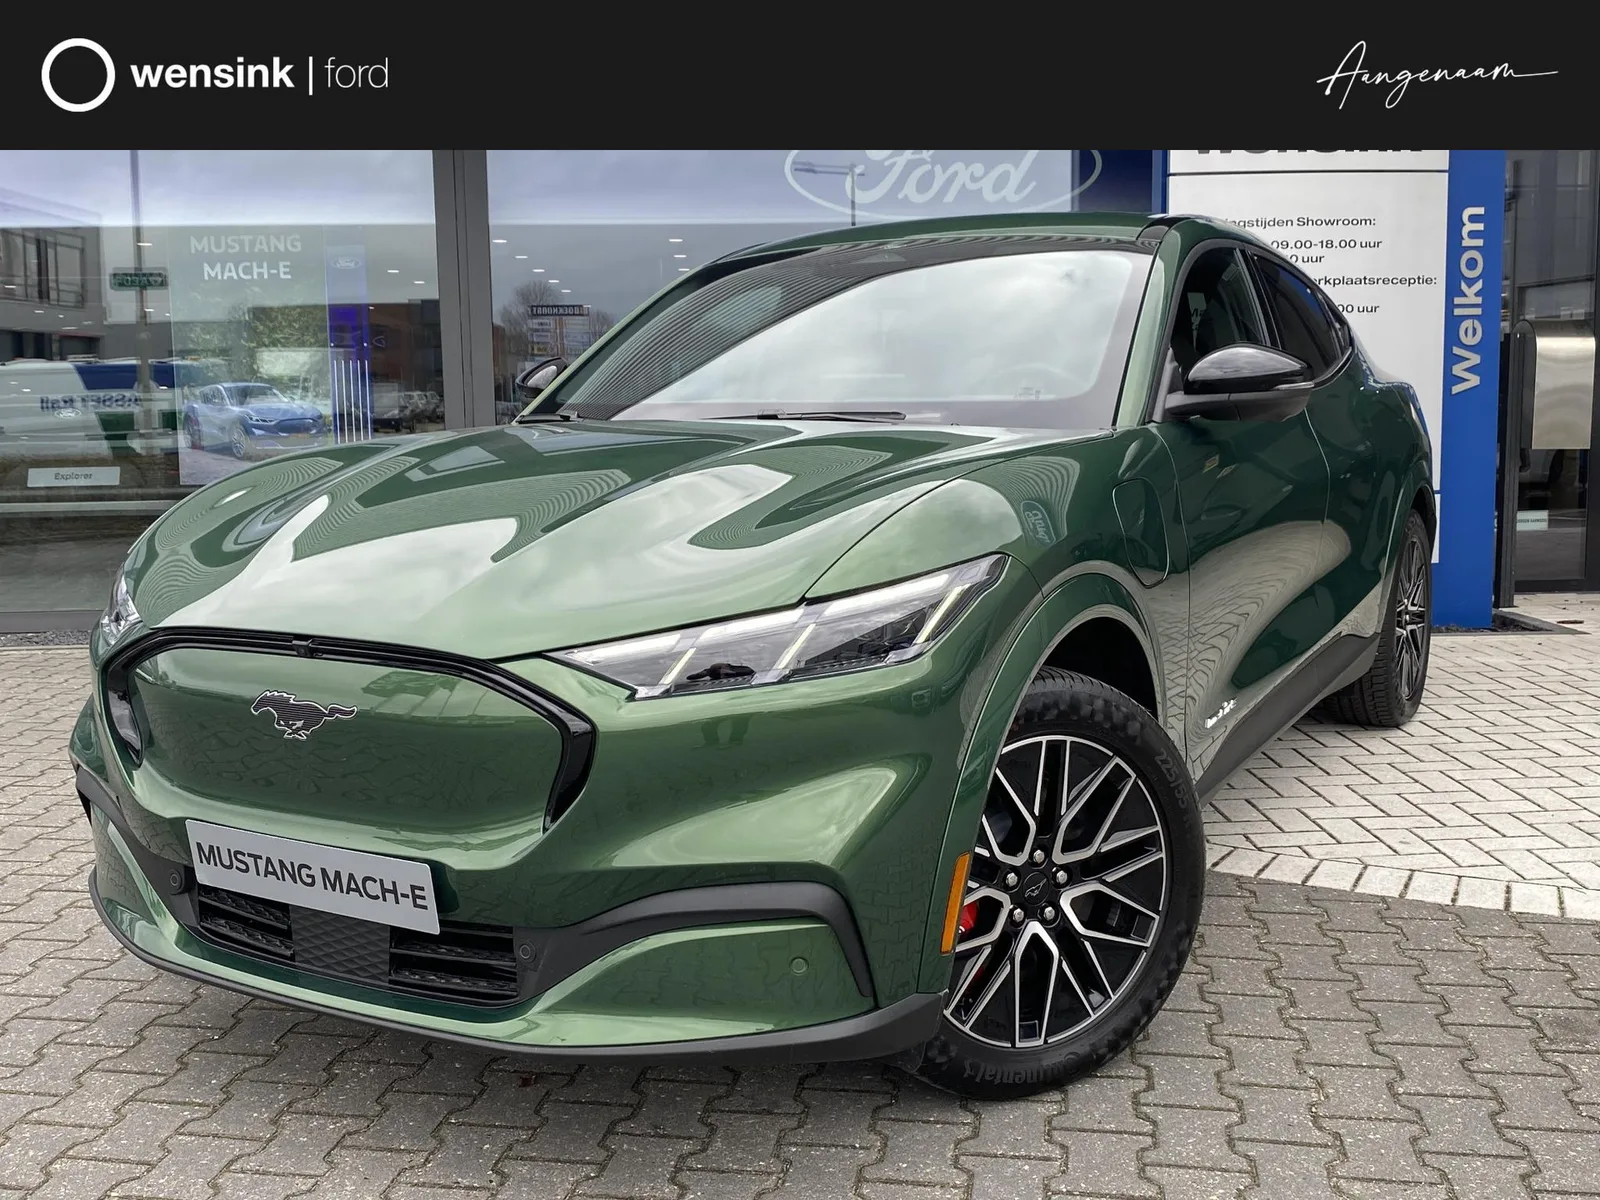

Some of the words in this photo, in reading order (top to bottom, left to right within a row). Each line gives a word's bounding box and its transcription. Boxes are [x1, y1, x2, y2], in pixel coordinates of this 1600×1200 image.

[845, 150, 1039, 203] Ford
[1296, 216, 1377, 227] Showroom:
[189, 235, 302, 254] MUSTANG
[1270, 239, 1357, 250] 09.00-18.00
[1360, 240, 1383, 249] uur
[1301, 255, 1325, 263] uur
[203, 261, 292, 280] MACH-E
[1313, 275, 1437, 287] rkplaatsreceptie:
[1451, 205, 1485, 395] Welkom
[1357, 305, 1380, 313] uur
[54, 472, 92, 481] Explorer
[196, 842, 316, 887] MUSTANG
[320, 867, 429, 910] MACH-E
